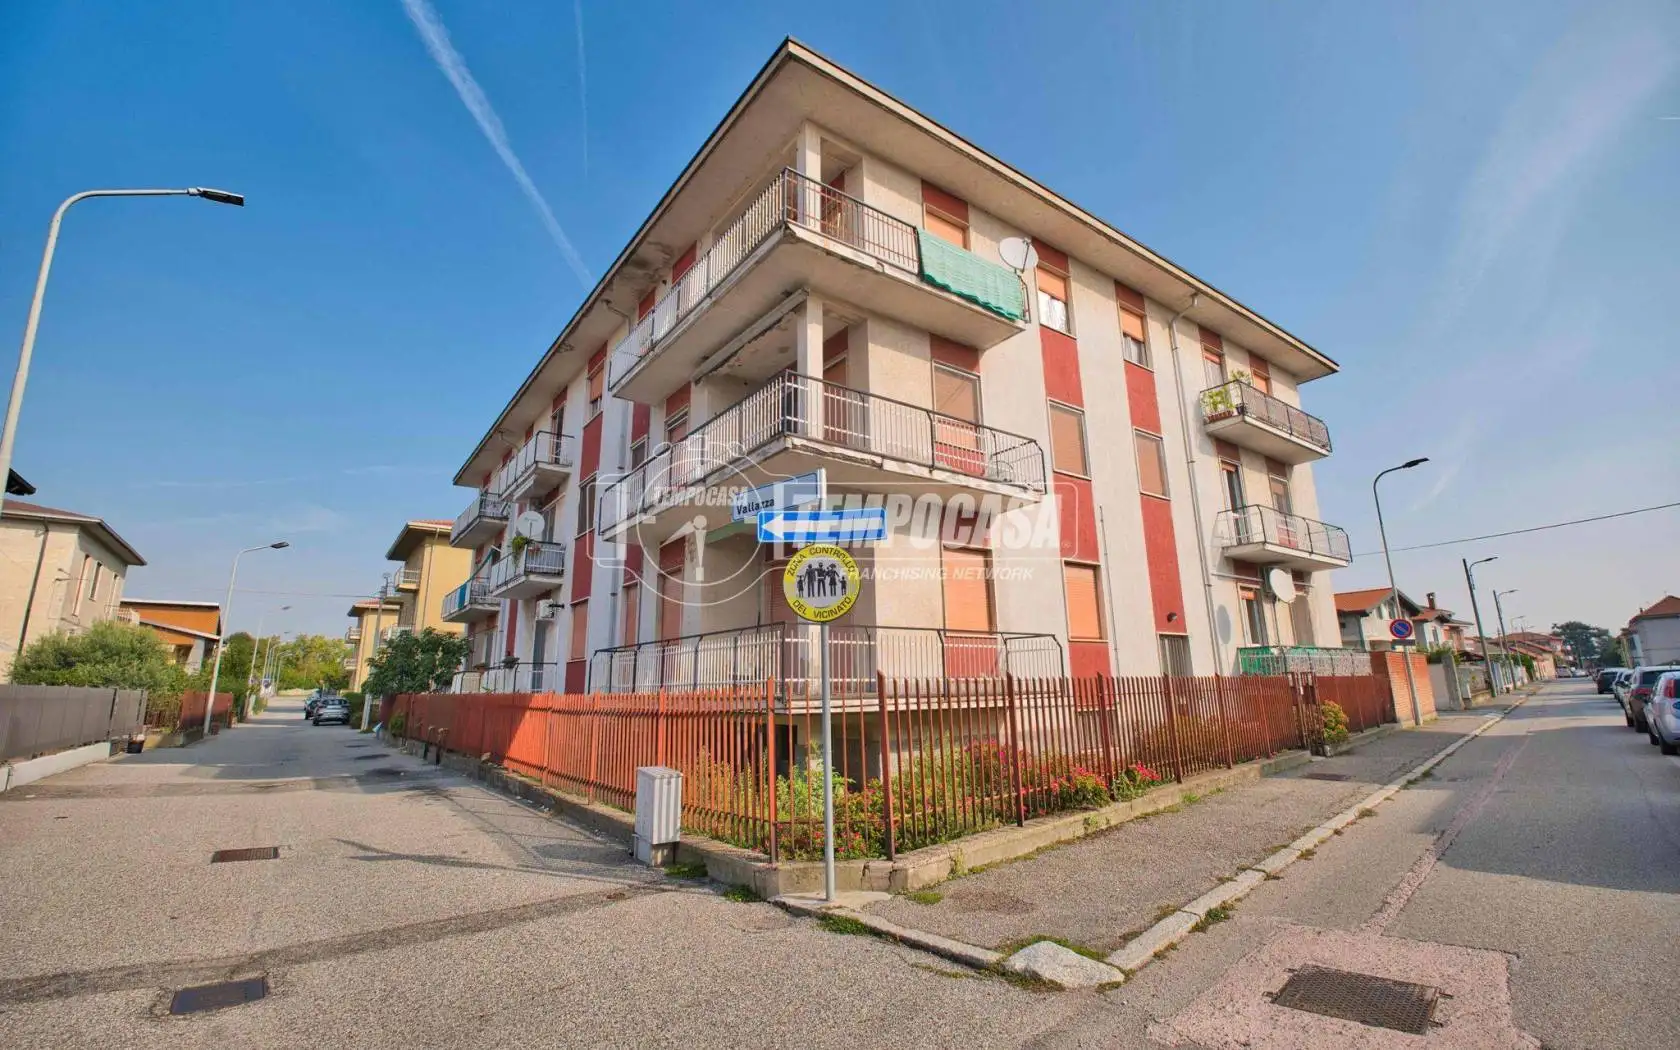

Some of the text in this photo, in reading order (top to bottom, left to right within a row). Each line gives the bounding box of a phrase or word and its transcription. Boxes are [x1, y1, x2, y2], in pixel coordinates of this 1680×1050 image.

[736, 498, 775, 515] Vallazza
[787, 547, 855, 576] ZONA CONTROLLO
[793, 596, 852, 619] DEL VICINATO
